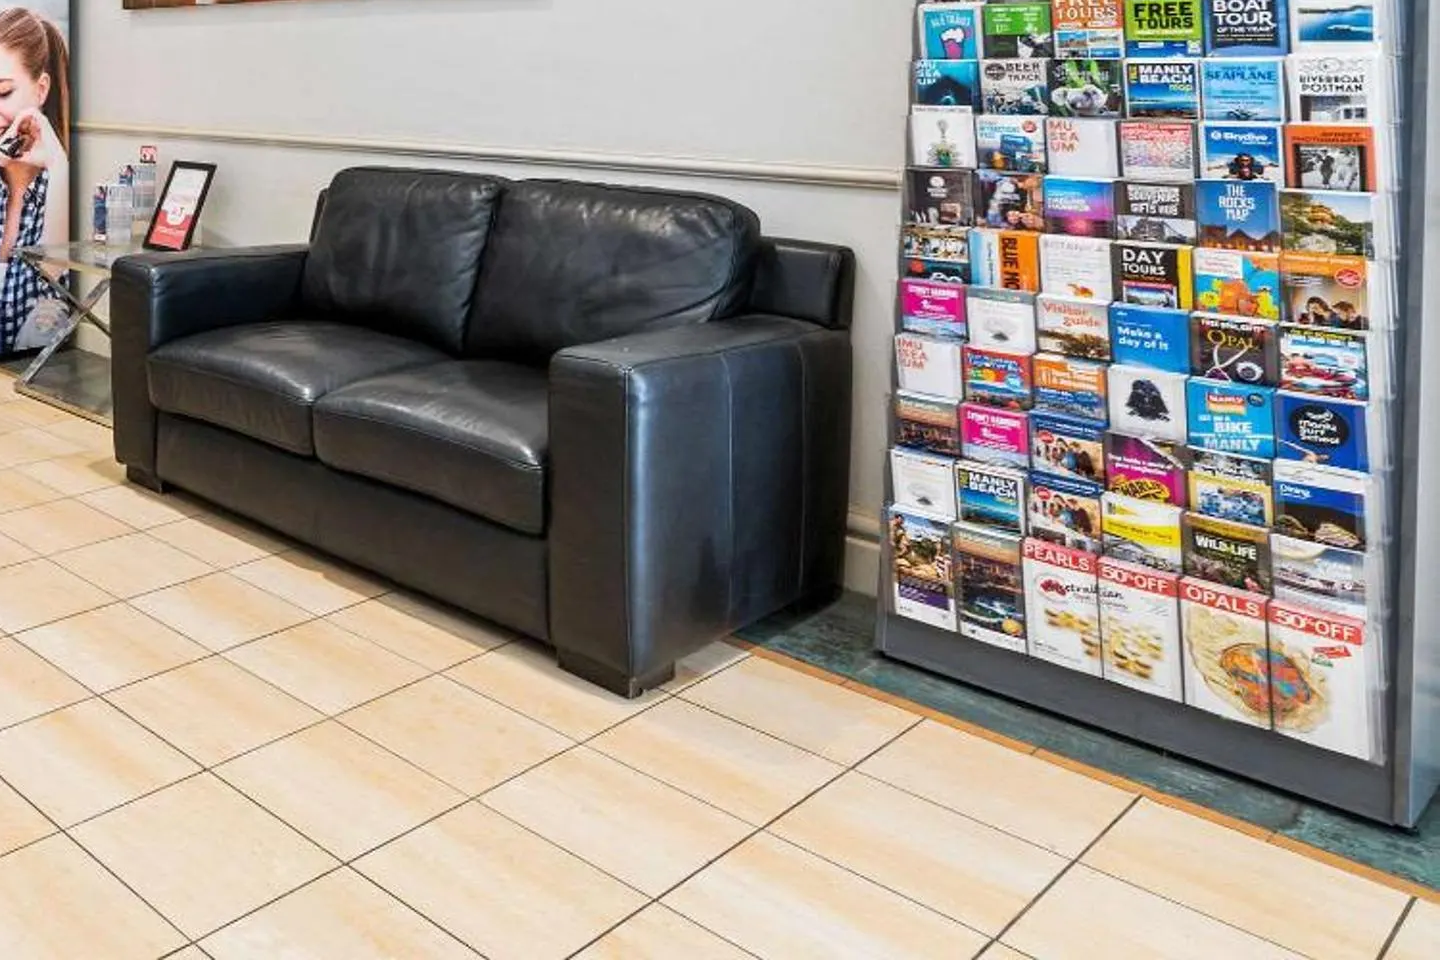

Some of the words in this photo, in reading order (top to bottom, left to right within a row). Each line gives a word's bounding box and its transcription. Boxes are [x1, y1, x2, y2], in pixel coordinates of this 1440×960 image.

[1056, 6, 1118, 20] TOURS
[1134, 1, 1193, 18] FREE
[1136, 15, 1194, 29] TOURS
[1213, 11, 1275, 27] TOUR
[1006, 62, 1040, 73] BEER
[1139, 64, 1194, 74] MANLY
[1139, 74, 1194, 84] BEACH
[1206, 70, 1277, 81] SEAPLANE
[1302, 83, 1363, 93] POSTMAN
[1227, 184, 1245, 197] THE
[1219, 196, 1255, 210] ROCKS
[1226, 207, 1251, 221] MAP
[1002, 237, 1019, 270] BLUE
[1123, 248, 1164, 264] DAY
[1122, 262, 1166, 276] TOURS
[1117, 326, 1150, 339] Make
[1118, 336, 1141, 349] day
[1143, 338, 1157, 349] of
[1213, 420, 1252, 434] BIKE
[1204, 436, 1260, 451] MANLY
[969, 471, 1015, 488] MANLY
[969, 481, 1016, 498] BEACH
[1024, 542, 1090, 571] PEARLS
[1231, 543, 1257, 560] LIFE
[1136, 575, 1169, 593] OFF
[1186, 586, 1260, 617] OPALS
[1315, 620, 1355, 640] OFF
